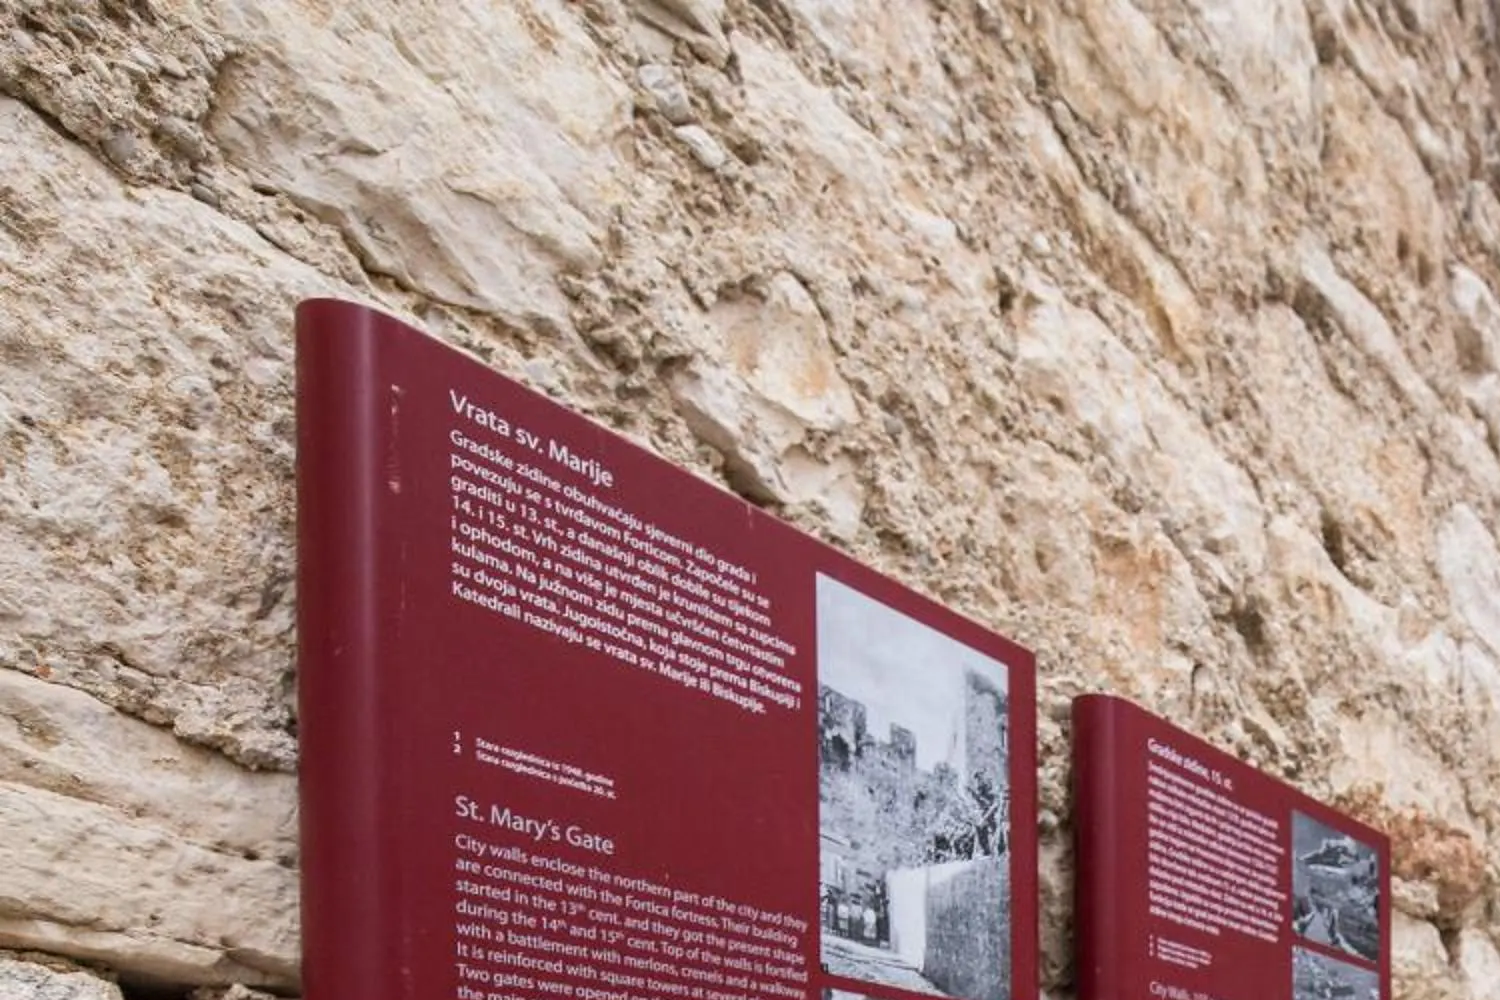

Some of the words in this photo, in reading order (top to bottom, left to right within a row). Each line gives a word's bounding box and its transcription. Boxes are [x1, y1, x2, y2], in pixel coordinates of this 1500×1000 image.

[449, 389, 510, 436] Vrata
[515, 428, 543, 453] sv.
[548, 439, 612, 487] Marije
[449, 429, 513, 470] Gradske
[515, 463, 561, 492] zidine
[450, 453, 522, 494] povezuju
[525, 487, 541, 504] se
[544, 497, 552, 508] s
[451, 475, 502, 506] graditi
[505, 499, 515, 512] u
[519, 503, 541, 524] 13.
[565, 527, 575, 539] a
[451, 515, 456, 529] i
[459, 522, 540, 566] ophodom,
[542, 557, 551, 569] a
[554, 562, 572, 578] na
[603, 581, 617, 597] je
[452, 495, 475, 516] 14.
[478, 505, 482, 519] i
[487, 510, 509, 531] 15.
[512, 523, 529, 540] st.
[531, 529, 557, 552] Vrh
[559, 544, 602, 570] zidina
[451, 536, 512, 574] kulama.
[515, 563, 536, 583] Na
[595, 599, 624, 620] zidu
[451, 562, 470, 578] su
[473, 569, 516, 596] dvoja
[519, 588, 560, 614] vrata.
[452, 580, 520, 619] Katedrali
[523, 611, 583, 643] nazivaju
[585, 635, 602, 650] se
[455, 795, 483, 821] St.
[490, 804, 560, 840] Mary's
[565, 825, 613, 854] Gate
[455, 833, 486, 856] City
[489, 844, 528, 863] walls
[530, 855, 585, 877] enclose
[587, 866, 611, 884] the
[613, 875, 671, 898] northern
[673, 889, 699, 905] part
[701, 895, 714, 907] of
[715, 898, 736, 913] the
[455, 858, 480, 873] are
[483, 864, 562, 892] connected
[565, 883, 597, 899] with
[599, 889, 622, 905] the
[625, 894, 669, 917] Fortica
[671, 904, 719, 928] fortress.
[720, 916, 750, 934] Their
[455, 879, 510, 901] started
[514, 889, 528, 905] in
[531, 894, 556, 911] the
[623, 916, 649, 931] and
[651, 920, 680, 940] they
[681, 929, 703, 943] got
[705, 932, 726, 948] the
[455, 898, 508, 924] during
[511, 910, 536, 927] the
[569, 925, 596, 939] and
[660, 940, 684, 959] Top
[685, 947, 699, 960] of
[700, 950, 721, 965] the
[723, 956, 752, 971] walls
[456, 922, 491, 939] with
[495, 930, 504, 942] a
[507, 929, 588, 958] battlement
[590, 948, 620, 964] with
[725, 975, 748, 988] and
[456, 962, 490, 982] Two
[493, 972, 534, 988] gates
[537, 979, 573, 995] were
[457, 941, 468, 956] It
[471, 944, 484, 959] is
[487, 949, 563, 973] reinforced
[565, 963, 597, 979] with
[599, 970, 644, 988] square
[646, 977, 689, 996] towers
[690, 987, 703, 998] at
[1149, 981, 1166, 1000] City
